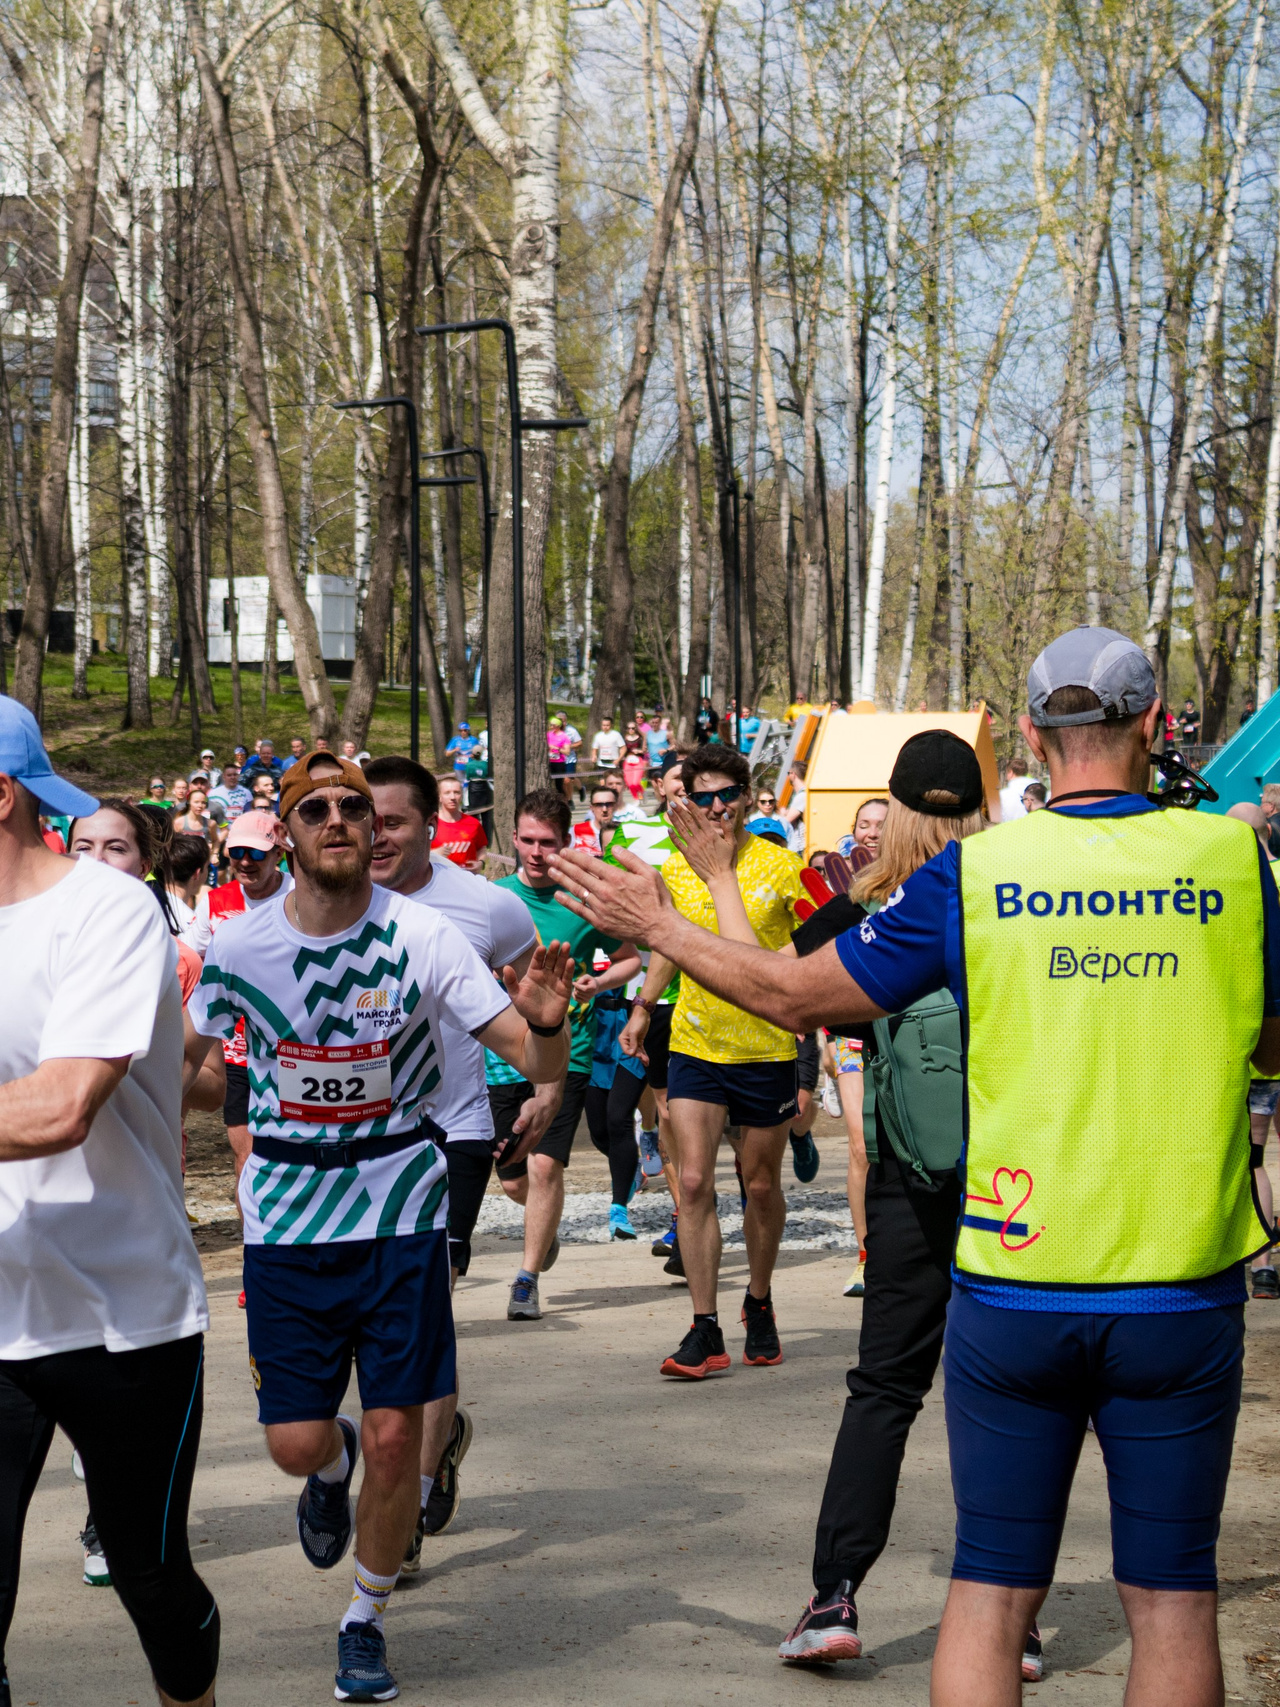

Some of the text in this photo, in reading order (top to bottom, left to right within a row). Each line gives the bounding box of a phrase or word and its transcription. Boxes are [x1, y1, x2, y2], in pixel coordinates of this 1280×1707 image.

[995, 877, 1224, 925] Волонтёр
[356, 1007, 401, 1020] МАЙСКАЯ
[373, 1017, 402, 1028] ГРОЗА
[352, 1059, 387, 1069] ВИКТОРИЯ
[301, 1077, 366, 1103] 282
